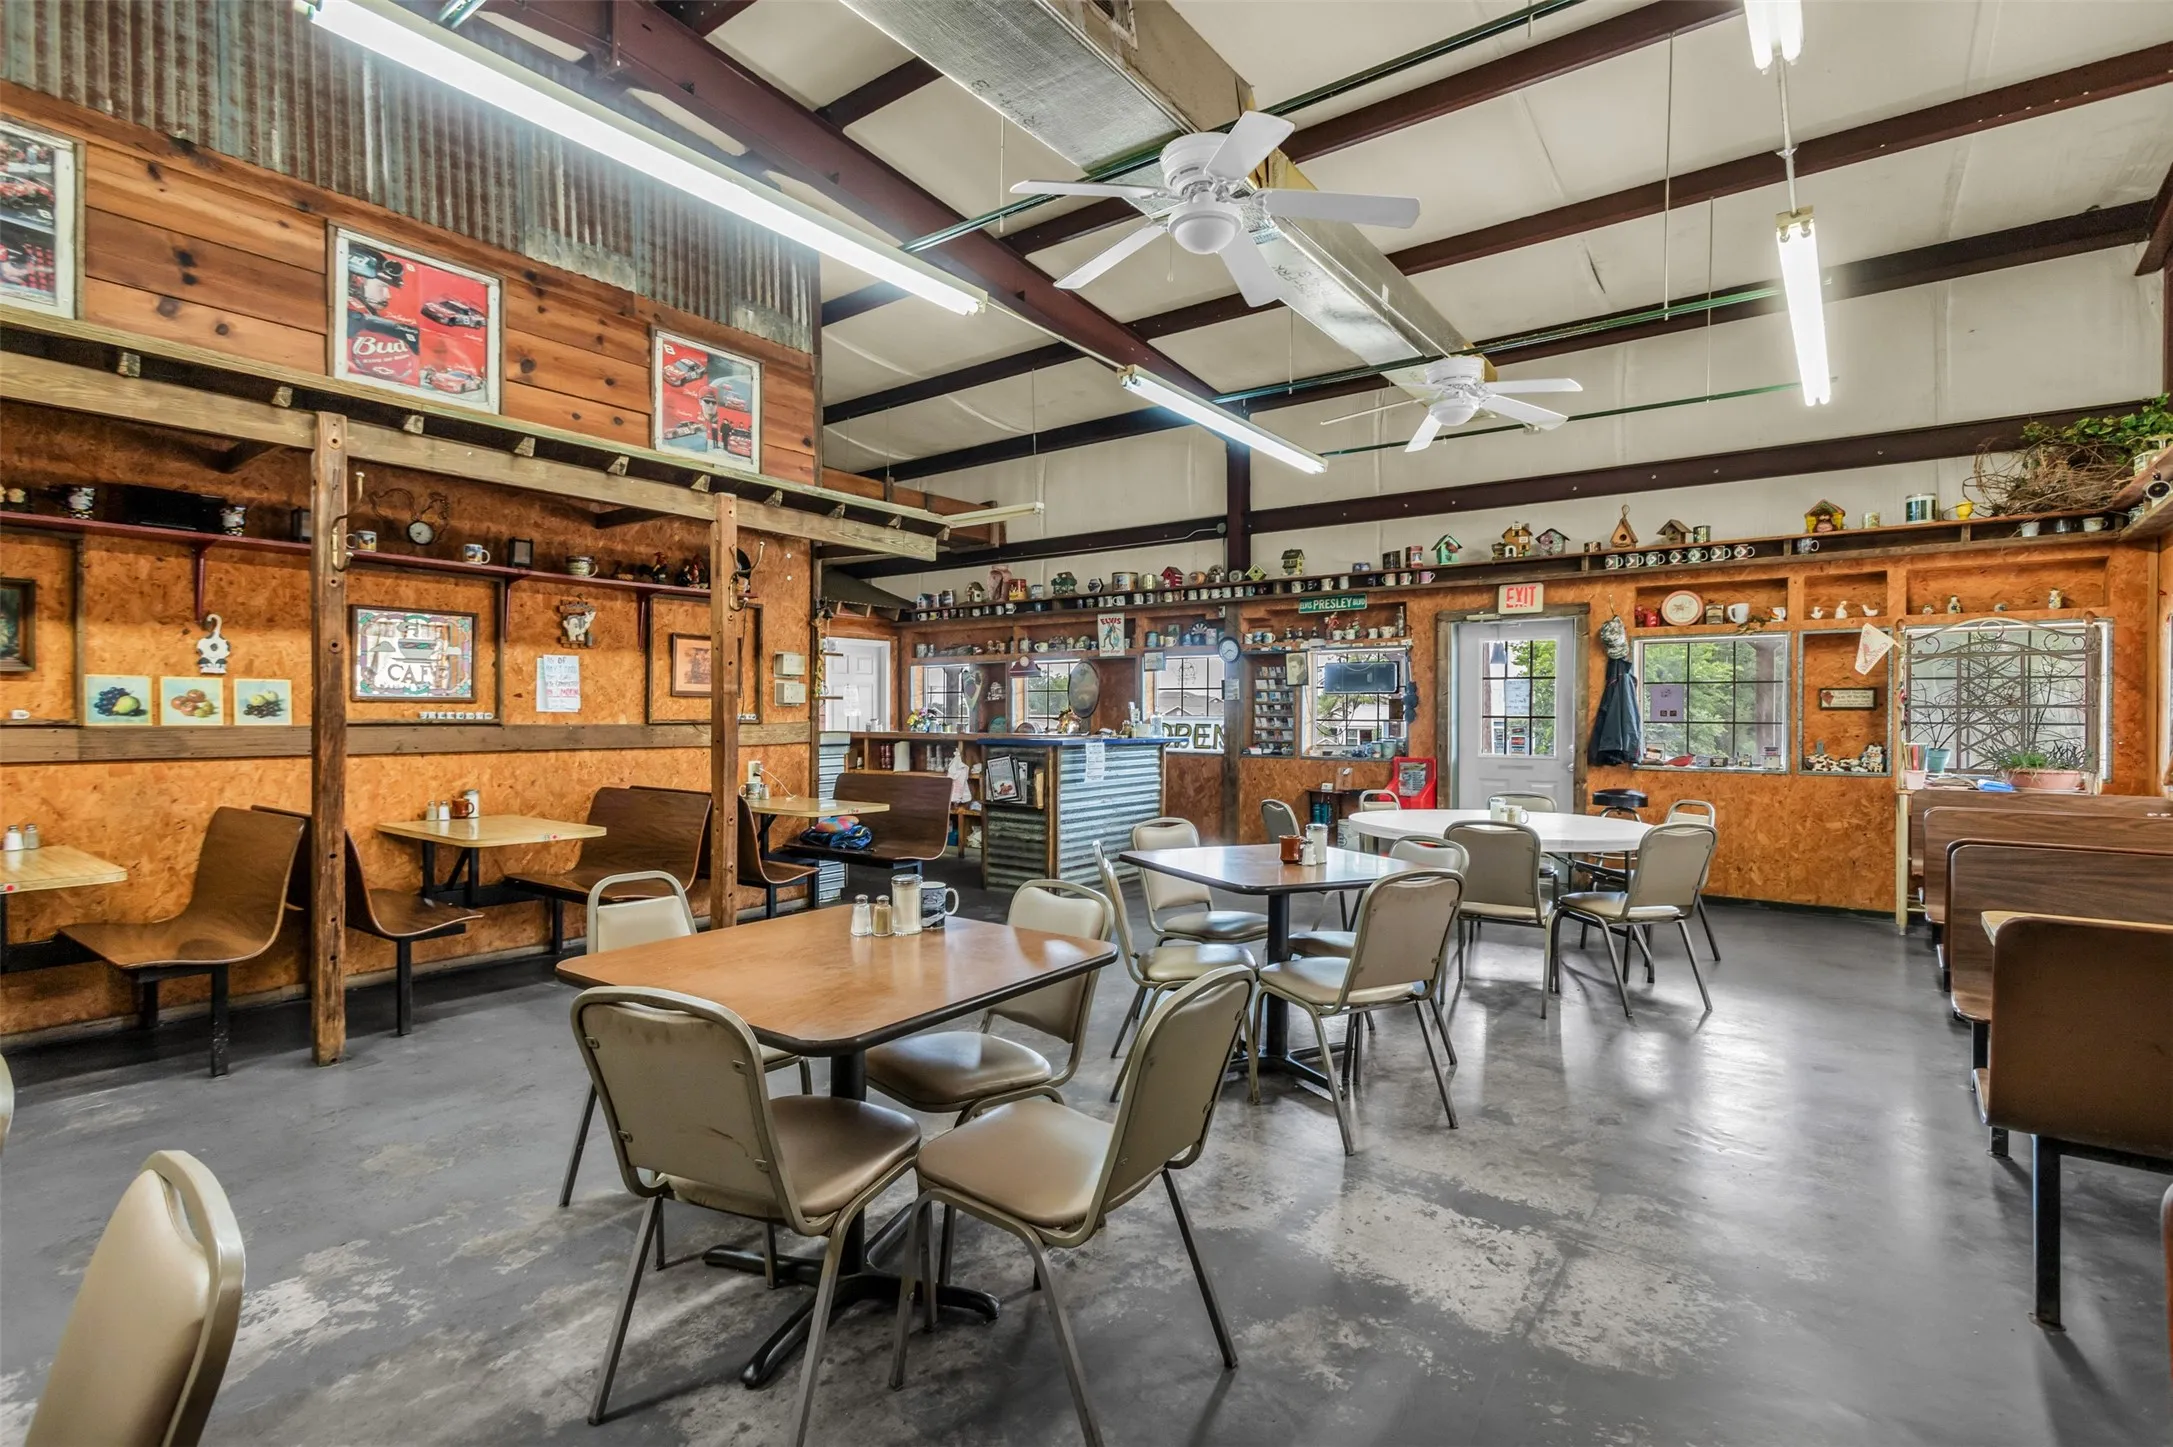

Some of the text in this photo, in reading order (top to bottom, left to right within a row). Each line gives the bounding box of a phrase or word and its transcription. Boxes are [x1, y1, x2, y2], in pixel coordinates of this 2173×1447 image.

[352, 336, 408, 355] Bud
[1300, 597, 1365, 610] ELVIS PRESLEY BLVD
[1505, 585, 1537, 609] EXIT
[1100, 617, 1122, 626] ELVIS
